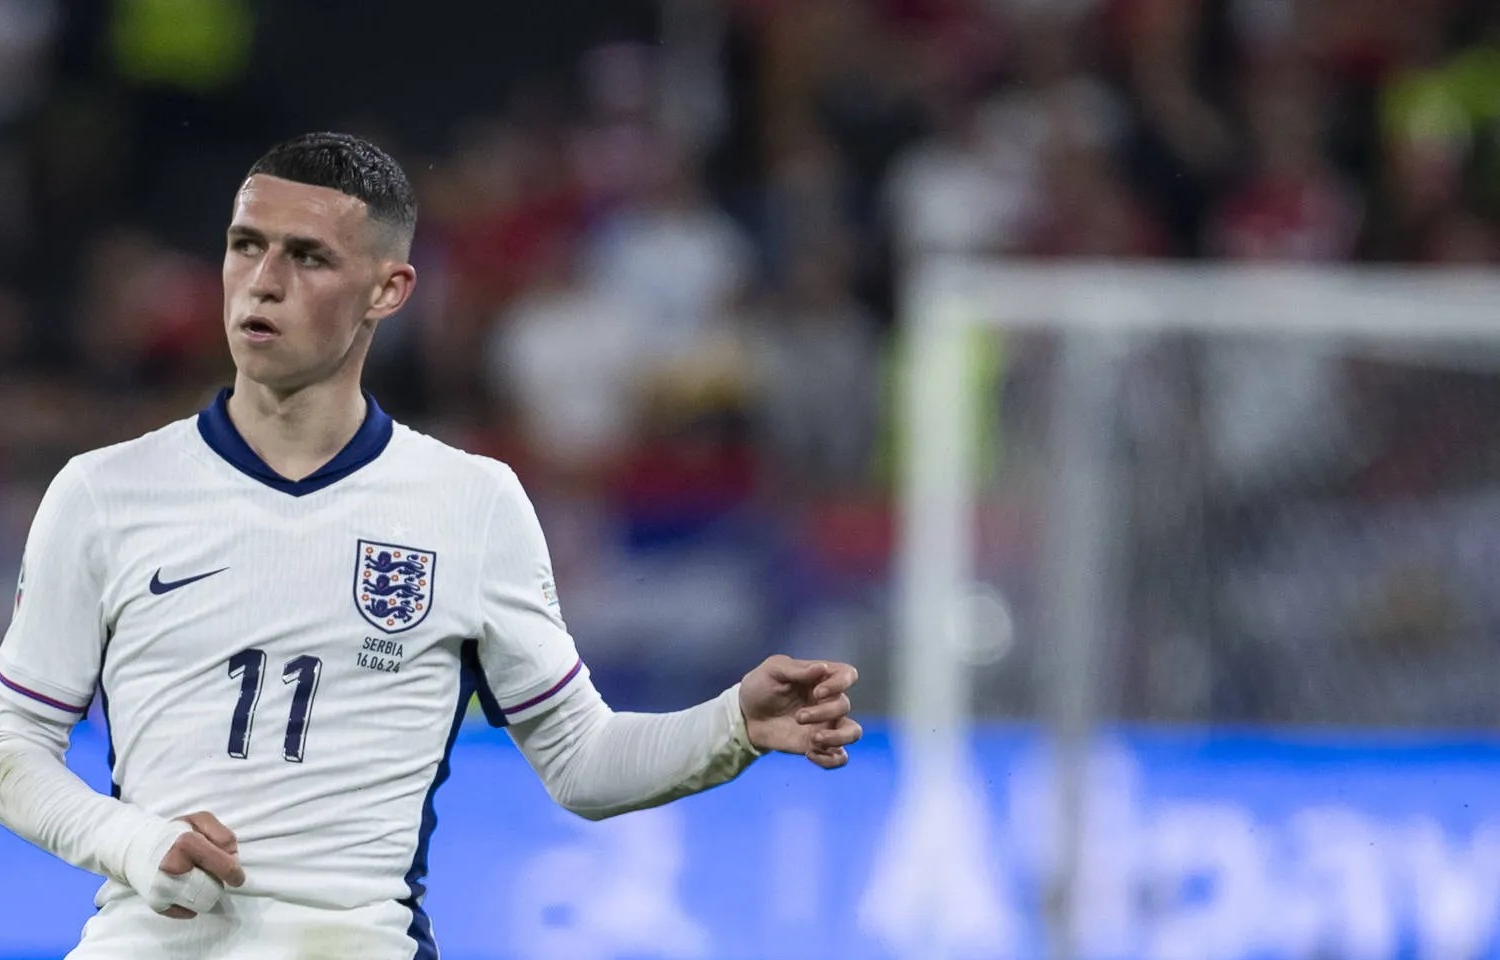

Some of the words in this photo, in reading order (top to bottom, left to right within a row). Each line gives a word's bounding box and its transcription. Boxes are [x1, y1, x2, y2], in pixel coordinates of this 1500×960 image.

[362, 636, 403, 658] SERBIA
[356, 652, 401, 674] 16.06.24
[228, 648, 322, 763] 11
